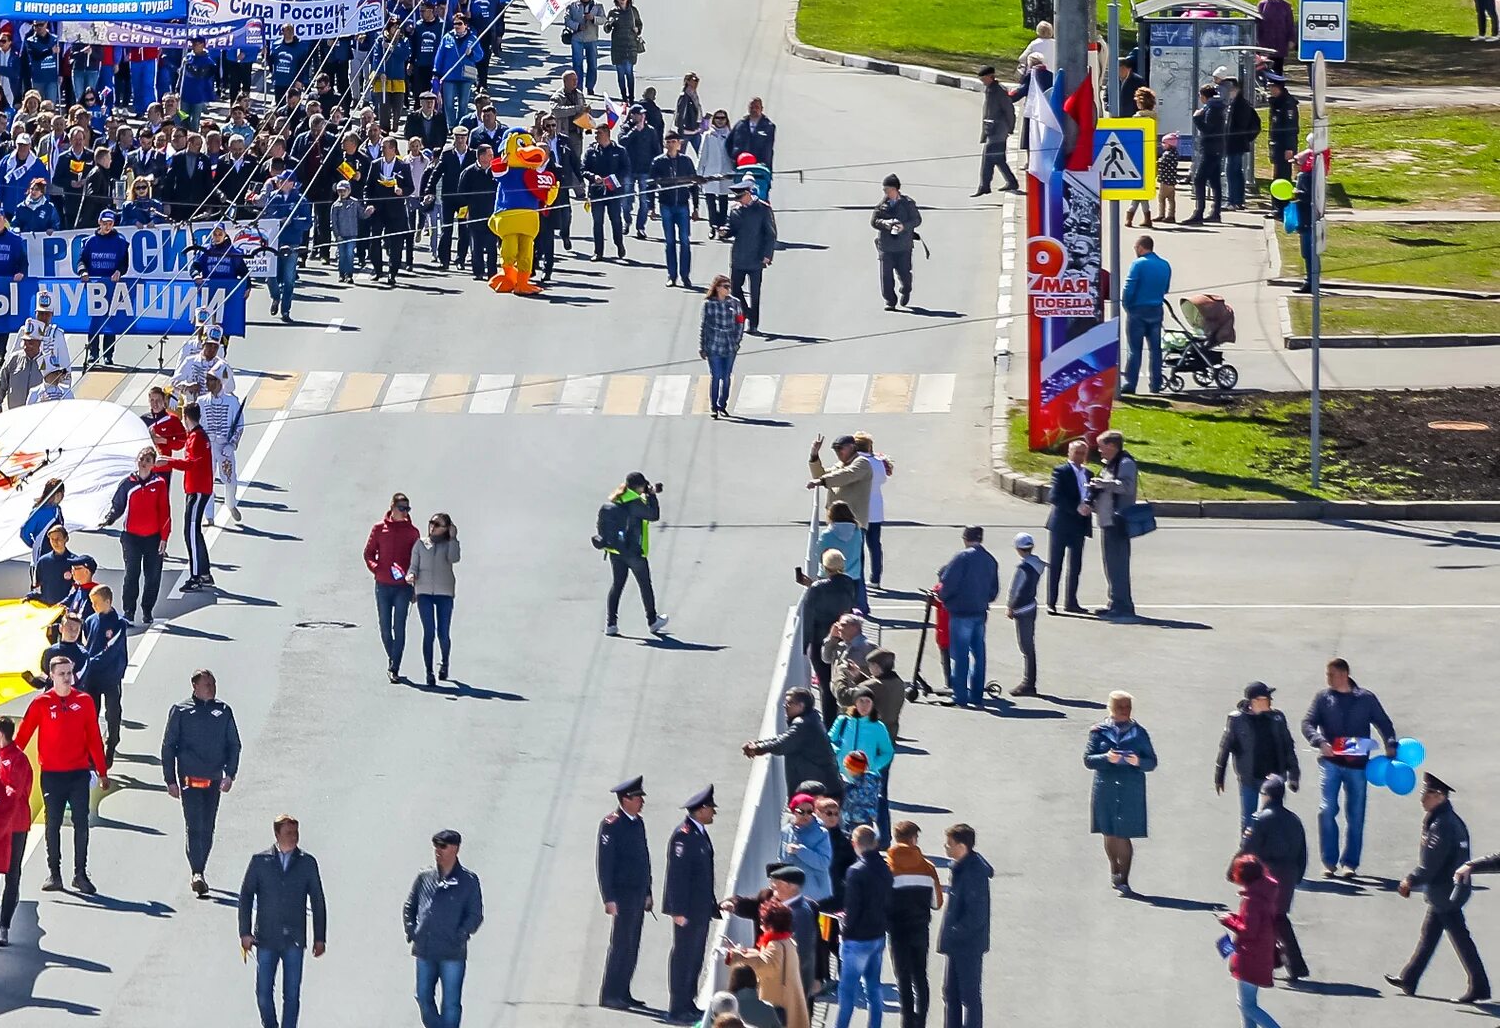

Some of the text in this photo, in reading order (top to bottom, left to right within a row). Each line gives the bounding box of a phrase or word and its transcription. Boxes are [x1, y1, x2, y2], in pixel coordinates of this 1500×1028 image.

[14, 3, 22, 12] в
[23, 3, 82, 16] интересах
[85, 2, 139, 14] человека
[161, 35, 171, 45] и
[1043, 278, 1089, 293] МАЯ
[38, 282, 227, 325] ЧУВАШИИ
[1035, 298, 1093, 308] ПОБЕДА
